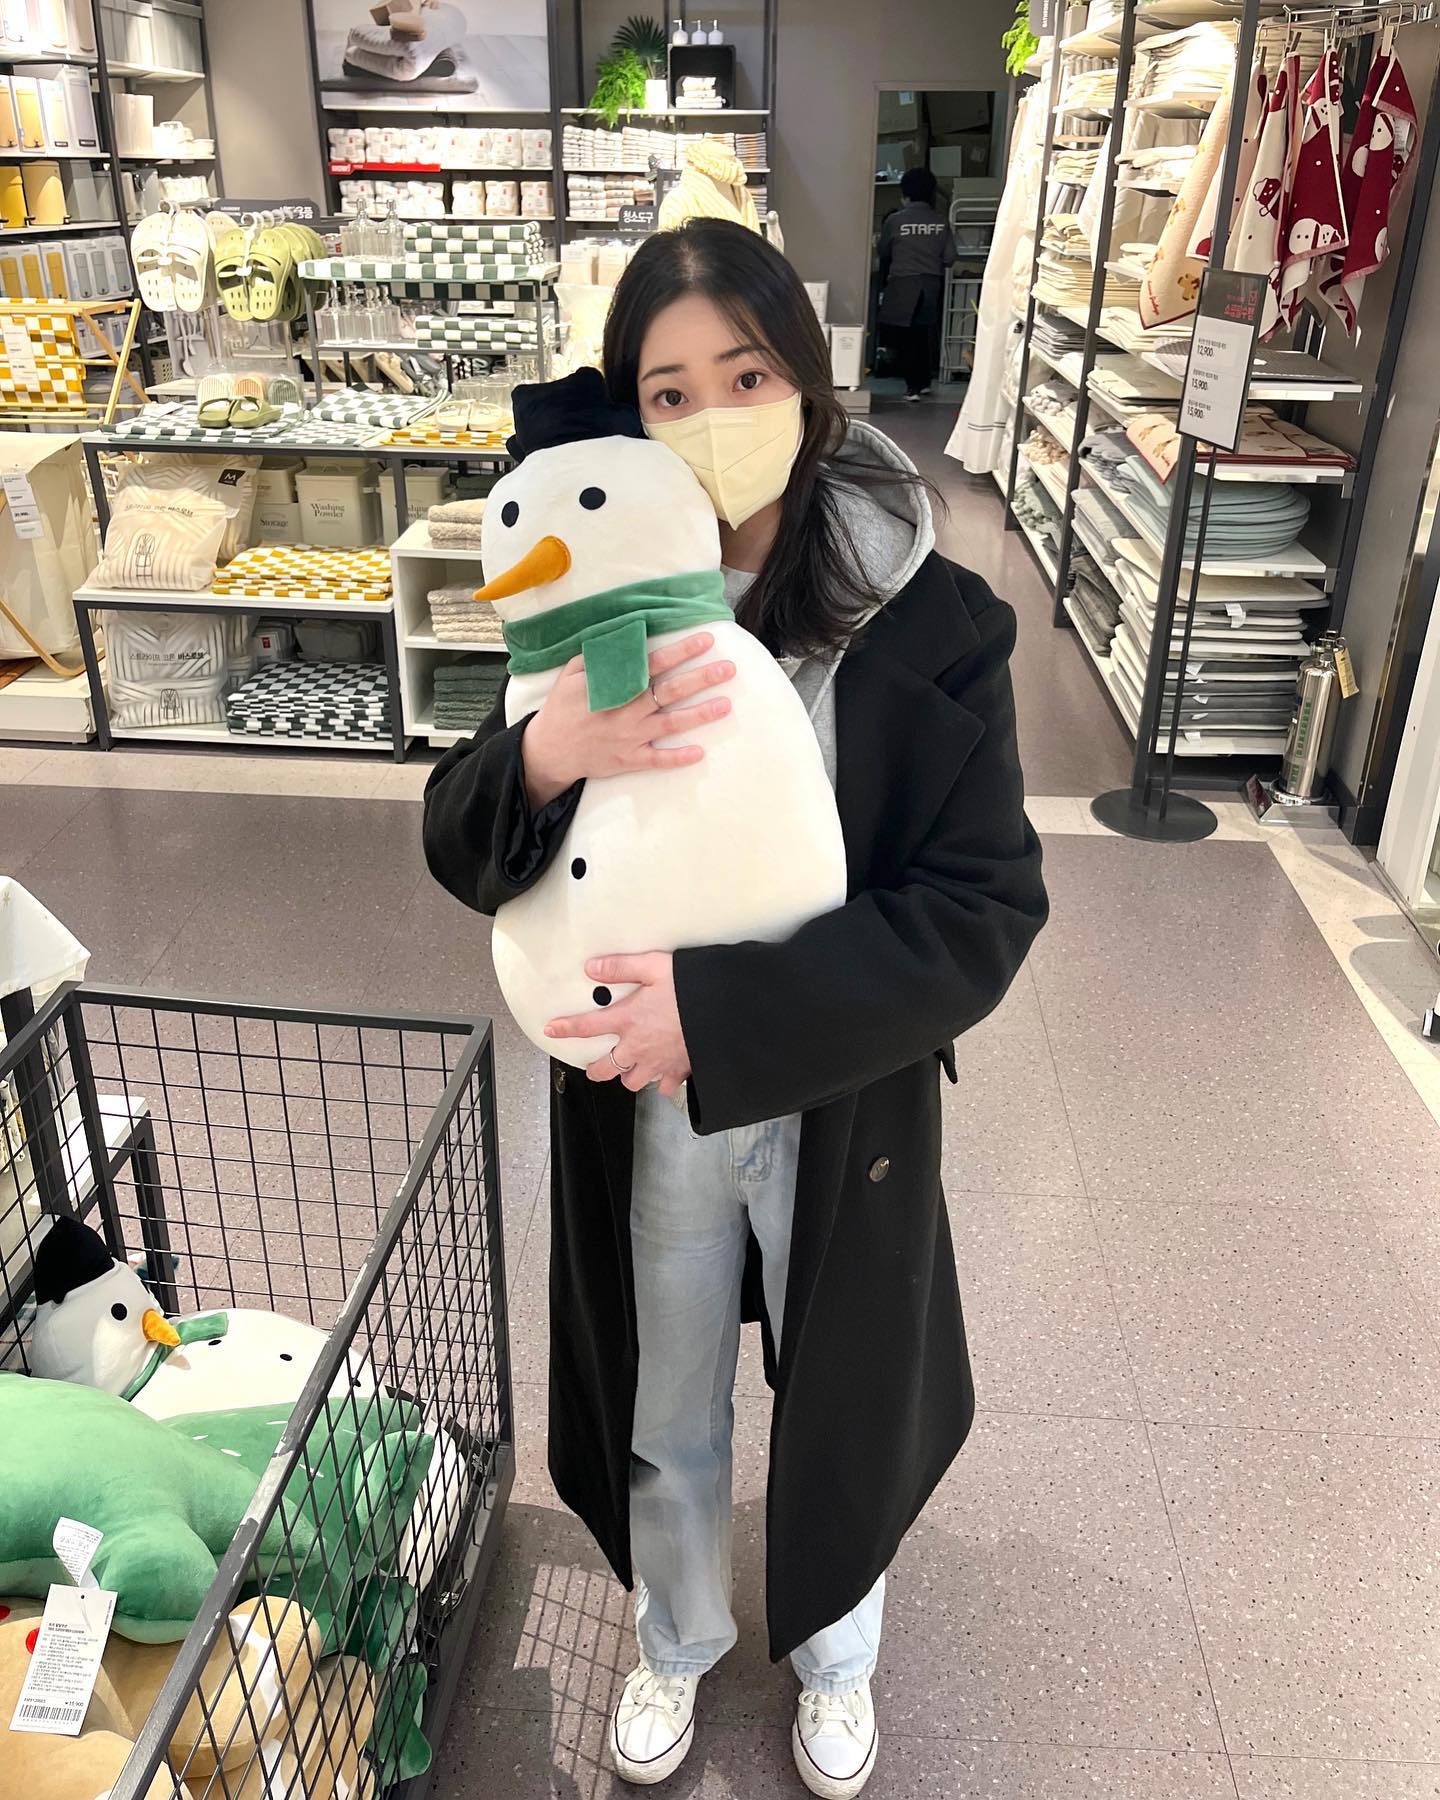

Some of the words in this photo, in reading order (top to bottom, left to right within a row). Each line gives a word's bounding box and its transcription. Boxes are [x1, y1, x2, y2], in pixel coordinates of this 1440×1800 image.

[623, 210, 654, 224] 청소도구
[900, 223, 945, 236] STAFF
[310, 503, 345, 512] Washing
[314, 510, 344, 518] Powder
